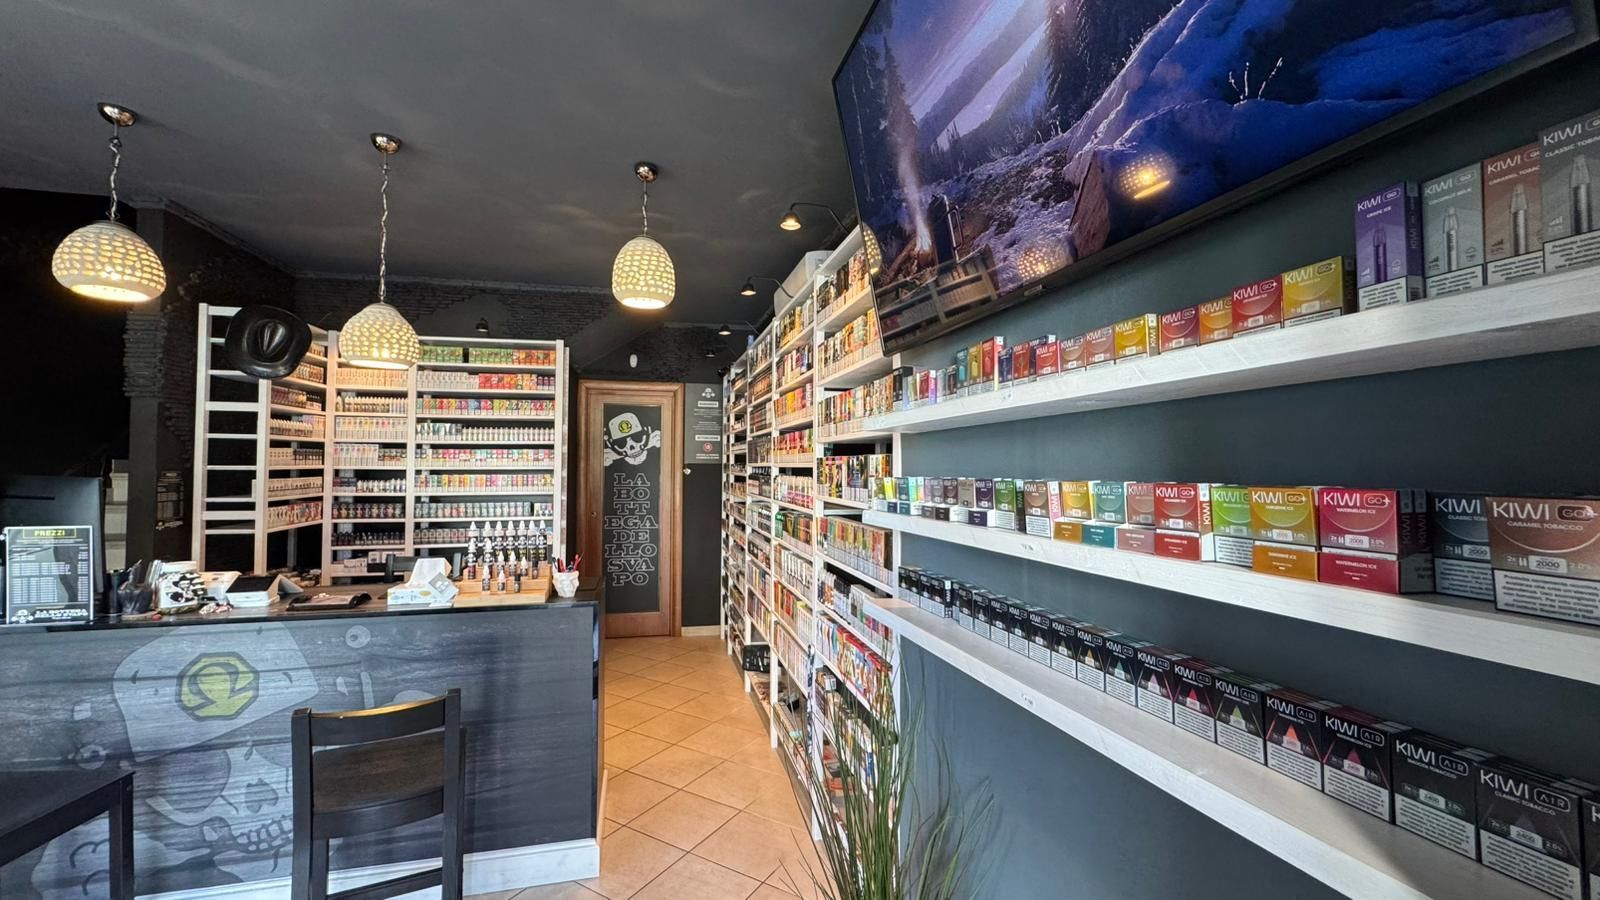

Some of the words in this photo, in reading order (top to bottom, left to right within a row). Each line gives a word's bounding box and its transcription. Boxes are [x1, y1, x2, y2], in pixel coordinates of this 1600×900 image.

[1543, 123, 1582, 146] KIWI
[1487, 154, 1521, 174] KIWI
[1424, 178, 1453, 195] KIWI
[1357, 195, 1381, 212] KIWI
[1284, 265, 1314, 285] KIWI
[1233, 284, 1258, 301] KIWI
[1201, 300, 1223, 315] KIWI
[1162, 311, 1181, 325] KIWI
[1086, 329, 1101, 341] KIWI
[1115, 321, 1132, 333] KIWI
[1094, 486, 1111, 495] KIWI
[1155, 487, 1178, 498] KIWI
[1214, 491, 1239, 502] KIWI
[1251, 490, 1282, 504] KIWI
[1323, 491, 1360, 507] KIWI
[1367, 496, 1391, 505] GO+
[1435, 498, 1481, 514] KIWI
[1202, 503, 1211, 526] KIWI
[1493, 502, 1549, 520] KIWI
[1507, 521, 1541, 529] CARAMEL
[1543, 523, 1583, 531] TOBACCO
[1536, 560, 1560, 569] 2000
[1077, 629, 1092, 643] KIWI
[1106, 640, 1122, 654] KIWI
[1137, 651, 1156, 666] KIWI
[1174, 664, 1196, 681] KIWI
[1215, 680, 1239, 697] KIWI
[1267, 695, 1294, 716] KIWI
[1300, 710, 1314, 720] AIR
[1325, 715, 1358, 738] KIWI
[1364, 732, 1381, 743] AIR
[1396, 739, 1436, 766] KIWI
[1443, 760, 1464, 773] AIR
[1480, 769, 1529, 800] KIWI
[1540, 793, 1566, 808] AIR
